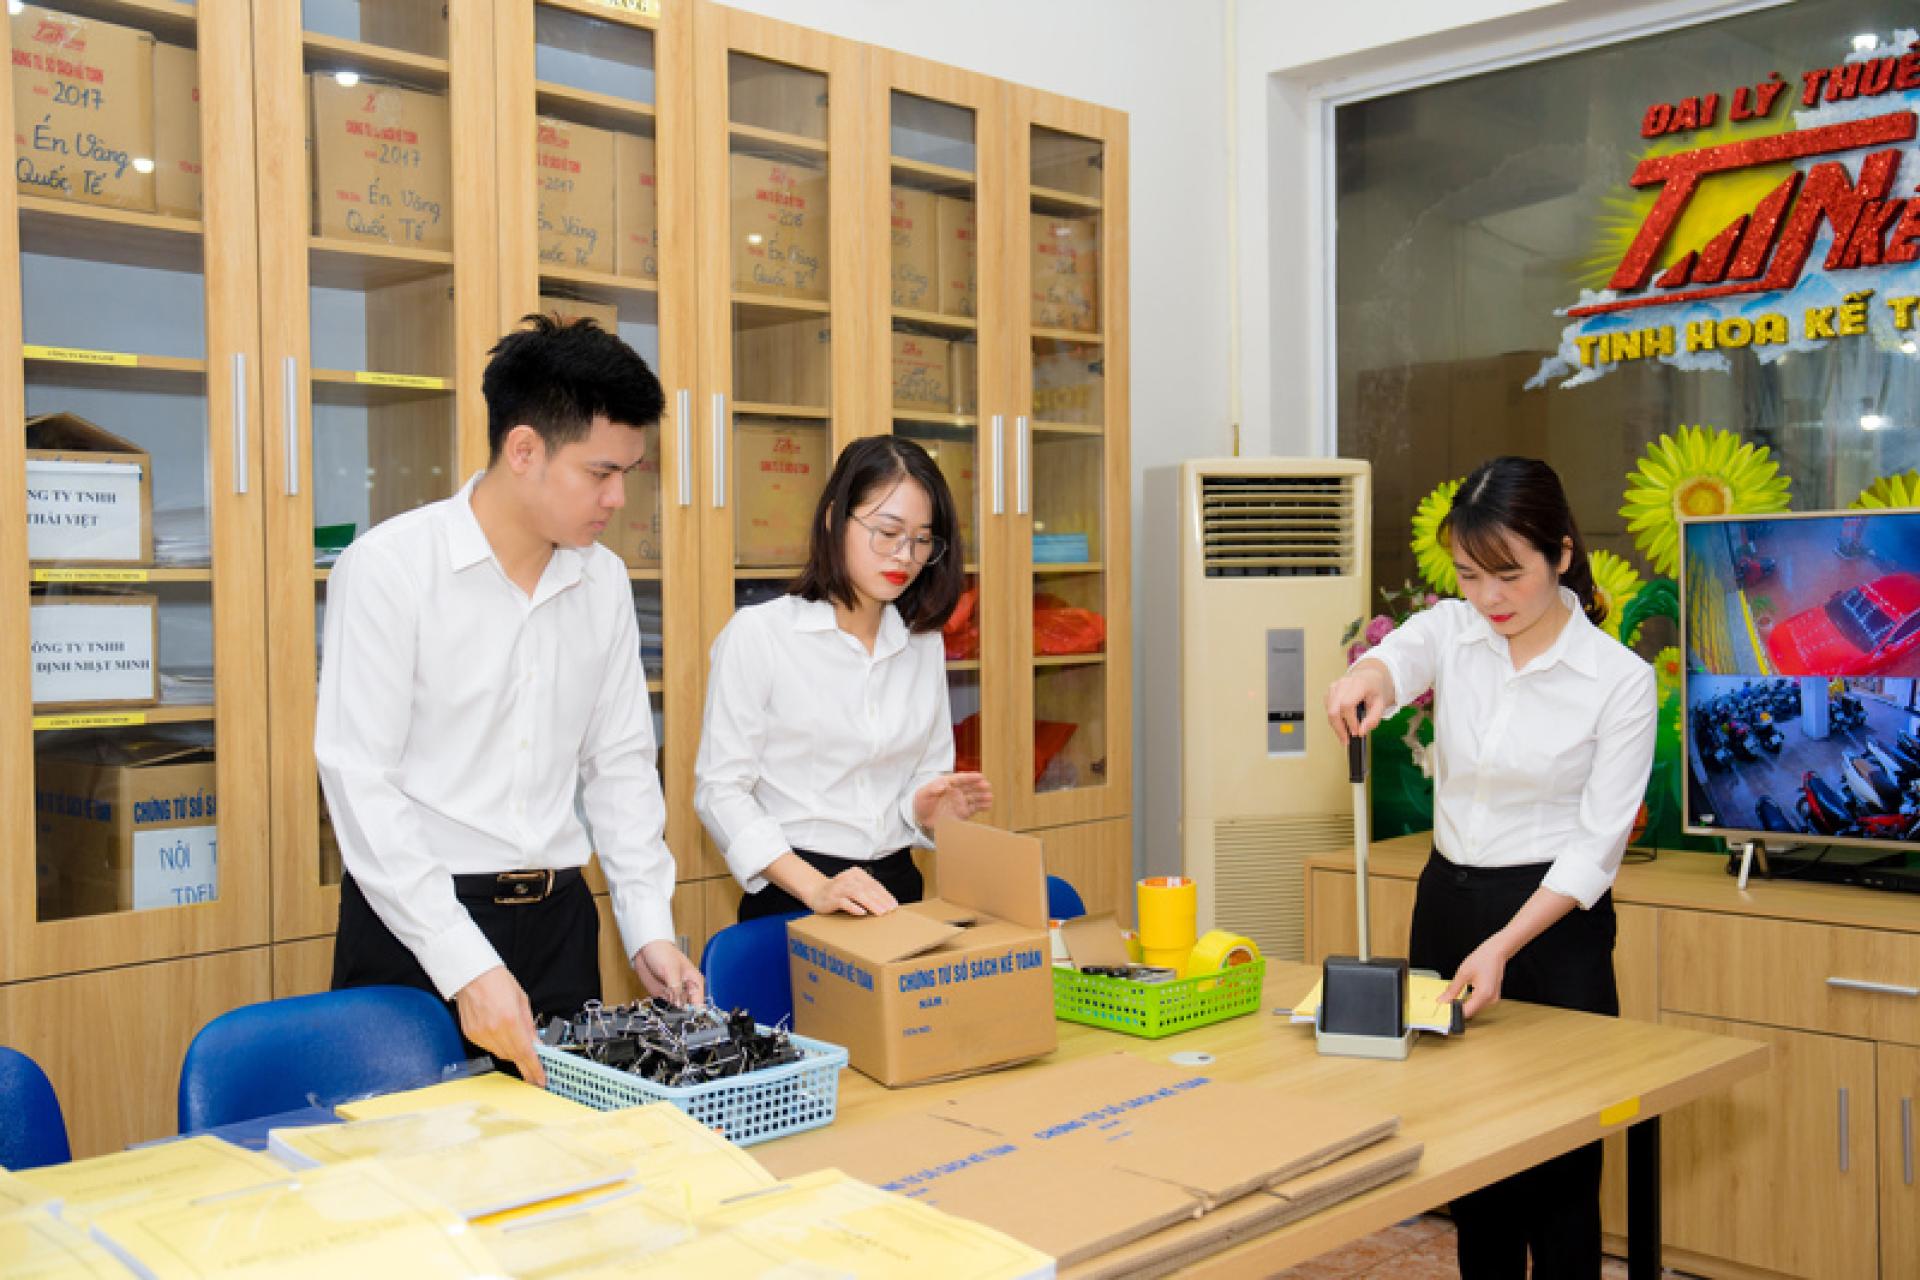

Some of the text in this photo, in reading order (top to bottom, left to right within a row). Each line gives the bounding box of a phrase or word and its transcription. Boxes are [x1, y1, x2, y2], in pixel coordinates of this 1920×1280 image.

[52, 80, 105, 110] 2017
[33, 113, 69, 154] Én
[1574, 326, 1676, 366] TINH
[1685, 314, 1789, 352] HOA
[1805, 287, 1876, 340] KẾ
[52, 490, 74, 503] TY
[76, 491, 117, 505] TNHH
[133, 795, 171, 824] CHỨNG
[898, 948, 1043, 993] CHỨNG TỪ SỔ SÁCH KẾ TOÁN
